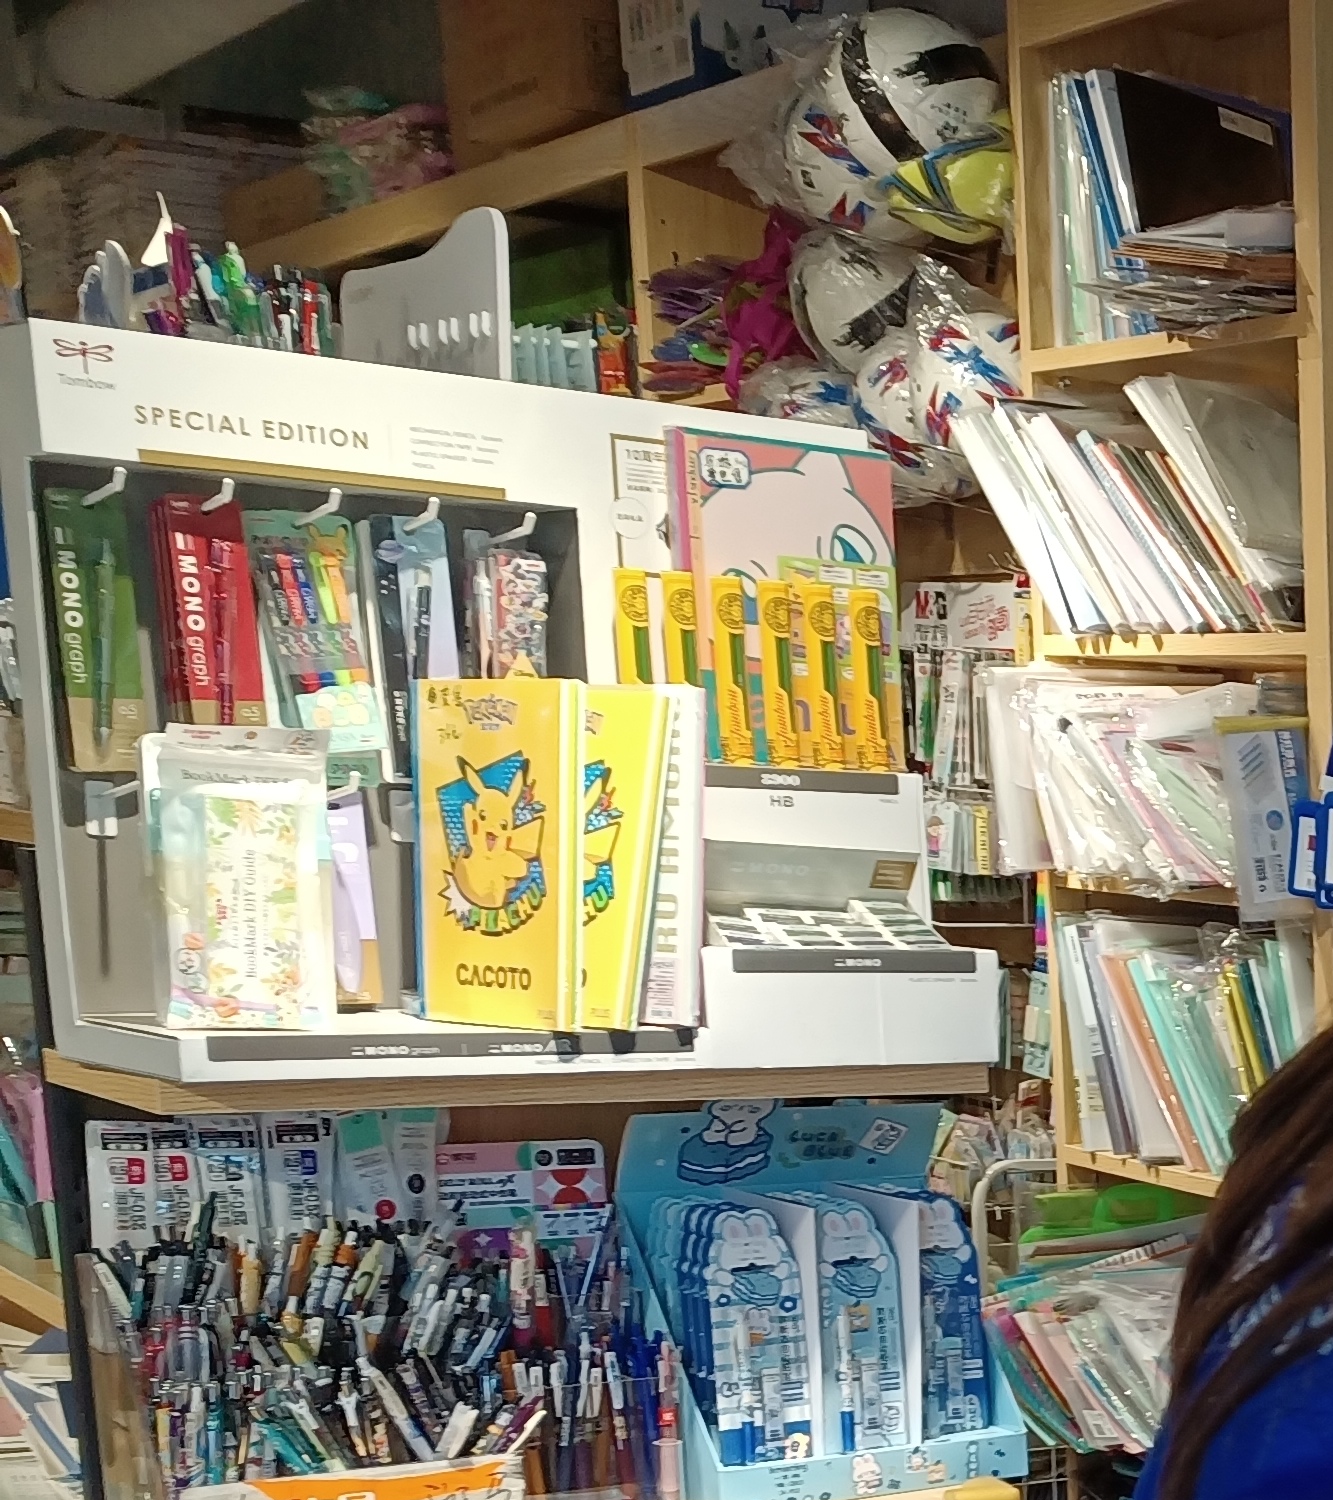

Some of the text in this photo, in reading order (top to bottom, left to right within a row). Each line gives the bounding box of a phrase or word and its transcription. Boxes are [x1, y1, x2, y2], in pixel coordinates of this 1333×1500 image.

[134, 404, 370, 449] SPECIAL EDITION
[57, 550, 88, 684] MONO graph
[174, 554, 212, 686] MONO graph
[456, 962, 532, 990] CACOTO
